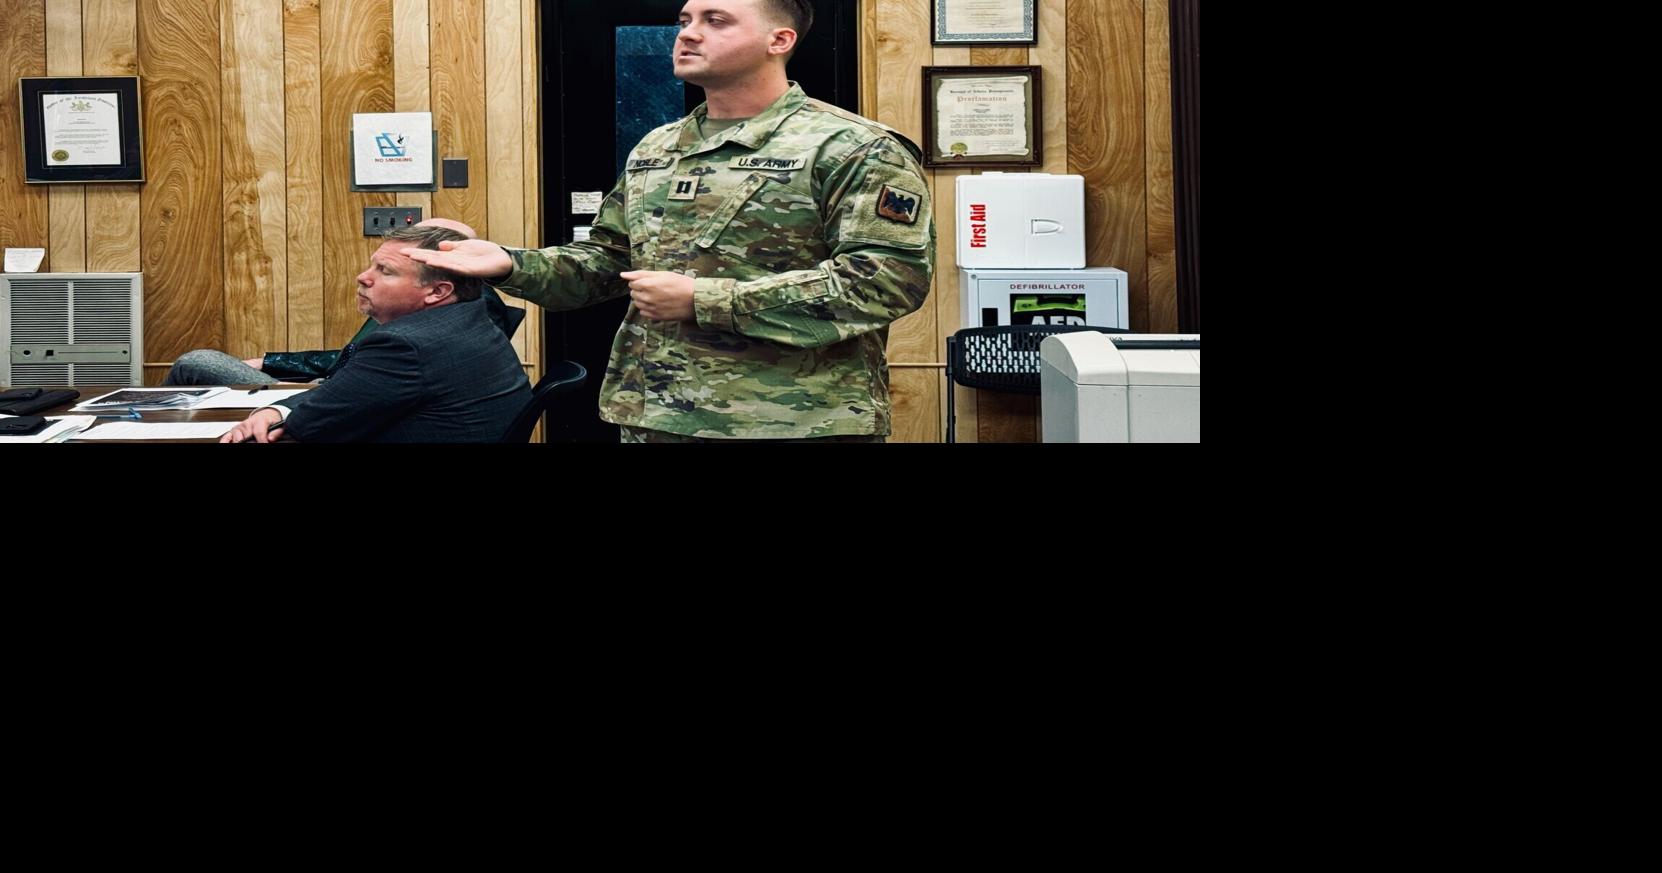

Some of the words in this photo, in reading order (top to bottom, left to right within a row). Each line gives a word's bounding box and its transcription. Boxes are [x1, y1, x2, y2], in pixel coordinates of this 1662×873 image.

[957, 95, 1007, 103] Proclamation
[738, 158, 761, 167] U.S.
[763, 158, 799, 168] ARMY
[970, 204, 986, 222] Aid
[970, 223, 987, 248] First
